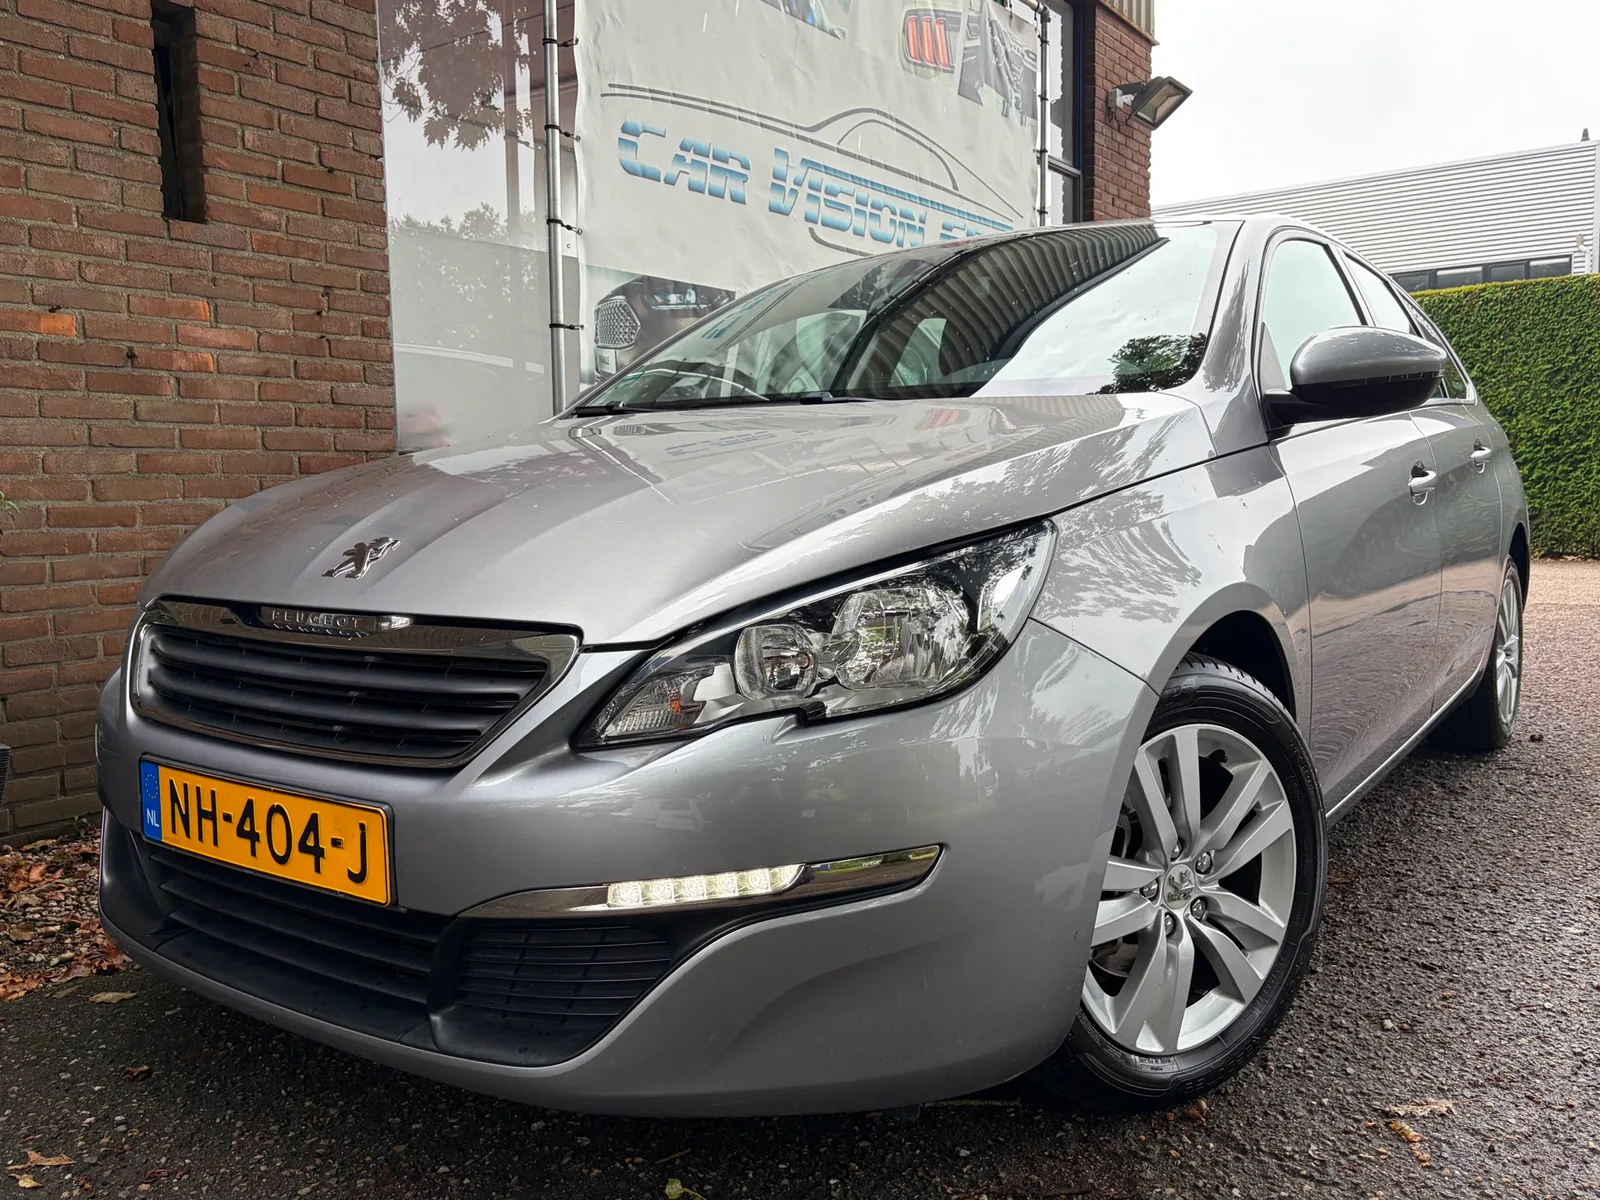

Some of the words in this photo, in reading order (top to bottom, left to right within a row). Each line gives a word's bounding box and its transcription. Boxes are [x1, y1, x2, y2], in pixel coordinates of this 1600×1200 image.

[618, 119, 751, 205] CAR
[768, 147, 927, 248] VISION
[271, 609, 363, 629] PEUGEOT
[146, 808, 160, 828] NL
[169, 778, 368, 885] NH-404-J
